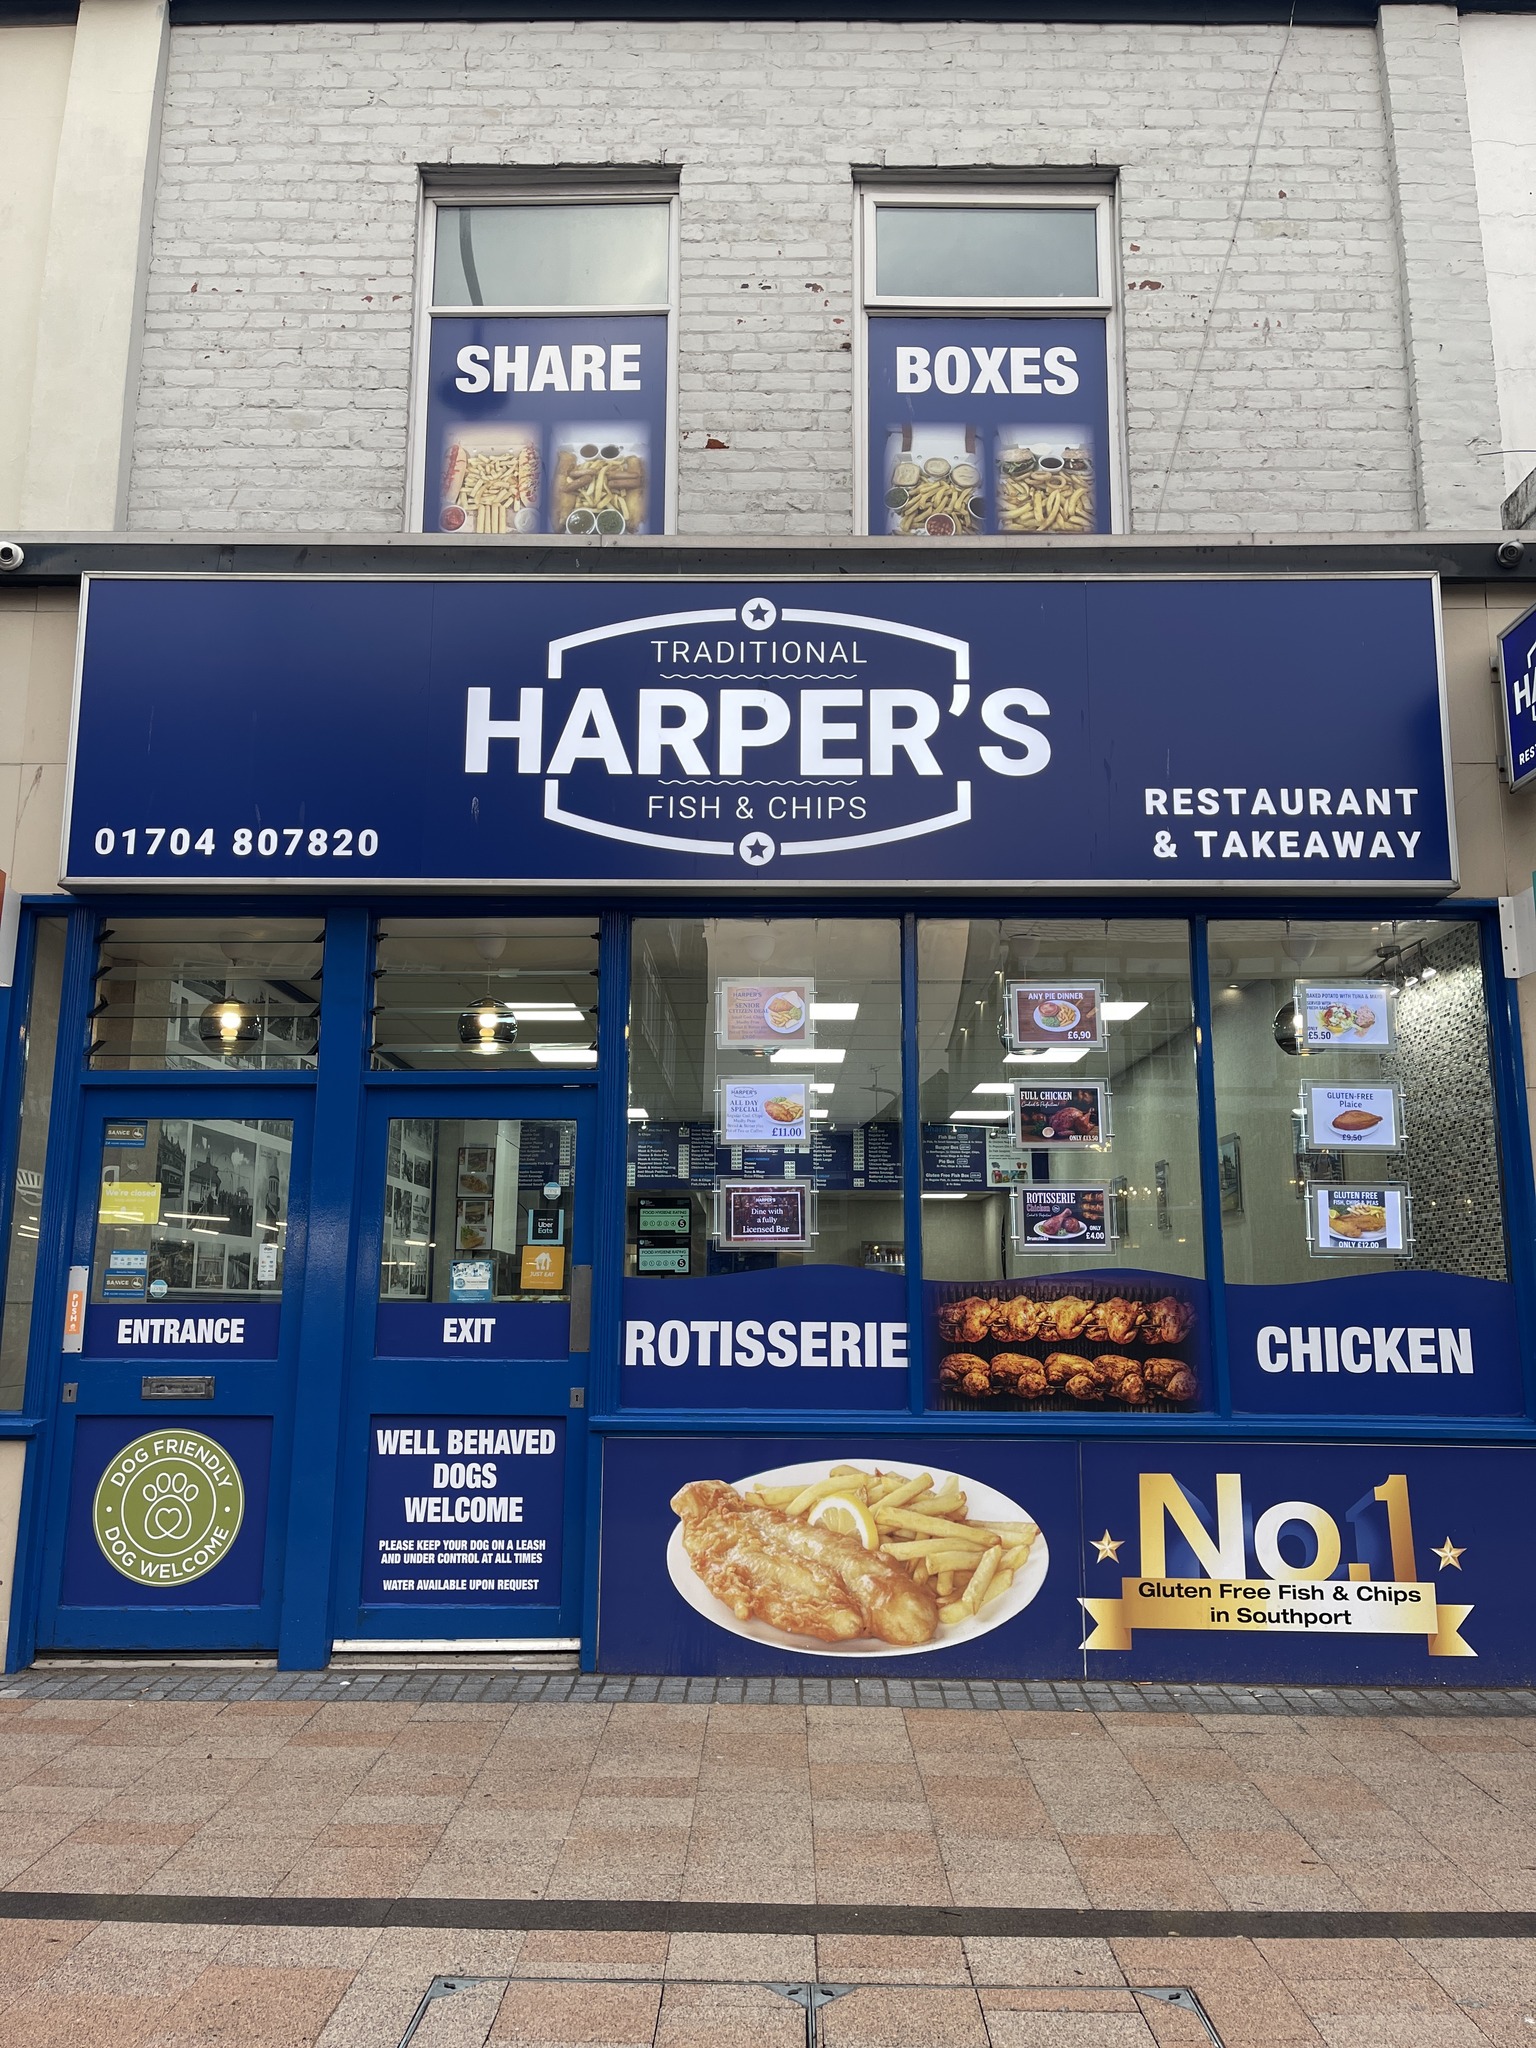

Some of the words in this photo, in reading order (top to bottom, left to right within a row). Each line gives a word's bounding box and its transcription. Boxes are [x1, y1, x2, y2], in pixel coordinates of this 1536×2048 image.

[455, 344, 641, 393] SHARE
[896, 346, 1080, 395] BOXES
[650, 640, 868, 664] TRADITIONAL
[464, 684, 1052, 777] HARPER'S
[648, 795, 721, 819] FISH
[735, 795, 755, 820] &
[768, 796, 868, 820] CHIPS
[1144, 787, 1419, 816] RESTAURANT
[94, 827, 216, 856] 01704
[232, 828, 379, 857] 807820
[1152, 830, 1178, 859] &
[1193, 830, 1422, 859] TAKEAWAY
[1057, 992, 1084, 1000] DINNER
[1308, 1032, 1331, 1040] £5.50
[1020, 1091, 1038, 1100] FULL
[1040, 1091, 1072, 1100] CHICKEN
[1326, 1092, 1374, 1100] GLUTEN-FREE
[772, 1127, 802, 1137] £11.00
[105, 1188, 129, 1197] We're
[130, 1188, 157, 1197] closed
[1026, 1192, 1076, 1204] ROTISSERIE
[1333, 1191, 1360, 1200] GLUTEN
[1361, 1192, 1378, 1200] FREE
[742, 1225, 775, 1234] Licensed
[776, 1225, 790, 1234] Bar
[762, 1216, 778, 1224] fully
[1086, 1232, 1104, 1240] £4.00
[70, 1293, 79, 1322] PUSH
[117, 1318, 245, 1344] ENTRANCE
[442, 1318, 496, 1343] EXIT
[625, 1319, 911, 1368] ROTISSERIE
[1256, 1325, 1474, 1374] CHICKEN
[376, 1429, 441, 1455] WELL
[447, 1429, 556, 1455] BEHAVED
[110, 1447, 150, 1488] DOG
[153, 1438, 233, 1488] FRIENDLY
[433, 1462, 498, 1489] DOGS
[404, 1496, 524, 1523] WELCOME
[1138, 1472, 1418, 1582] No.1
[104, 1525, 137, 1568] DOG
[139, 1525, 230, 1579] WELCOME
[379, 1540, 414, 1551] PLEASE
[416, 1540, 441, 1551] KEEP
[442, 1540, 468, 1551] YOUR
[470, 1540, 490, 1551] DOG
[492, 1540, 505, 1551] ON
[506, 1540, 514, 1551] A
[516, 1540, 546, 1551] LEASH
[380, 1553, 402, 1564] AND
[403, 1553, 435, 1564] UNDER
[437, 1553, 480, 1564] CONTROL
[481, 1553, 494, 1564] AT
[494, 1553, 512, 1564] ALL
[514, 1553, 543, 1564] TIMES
[382, 1579, 415, 1591] WATER
[416, 1579, 467, 1591] AVAILABLE
[469, 1579, 496, 1591] UPON
[497, 1579, 540, 1592] REQUEST
[1138, 1581, 1212, 1600] Gluten
[1219, 1582, 1271, 1601] Free
[1278, 1584, 1324, 1602] Fish
[1332, 1586, 1350, 1602] &
[1356, 1585, 1422, 1607] Chips
[1210, 1607, 1230, 1624] in
[1236, 1607, 1352, 1629] Southport
